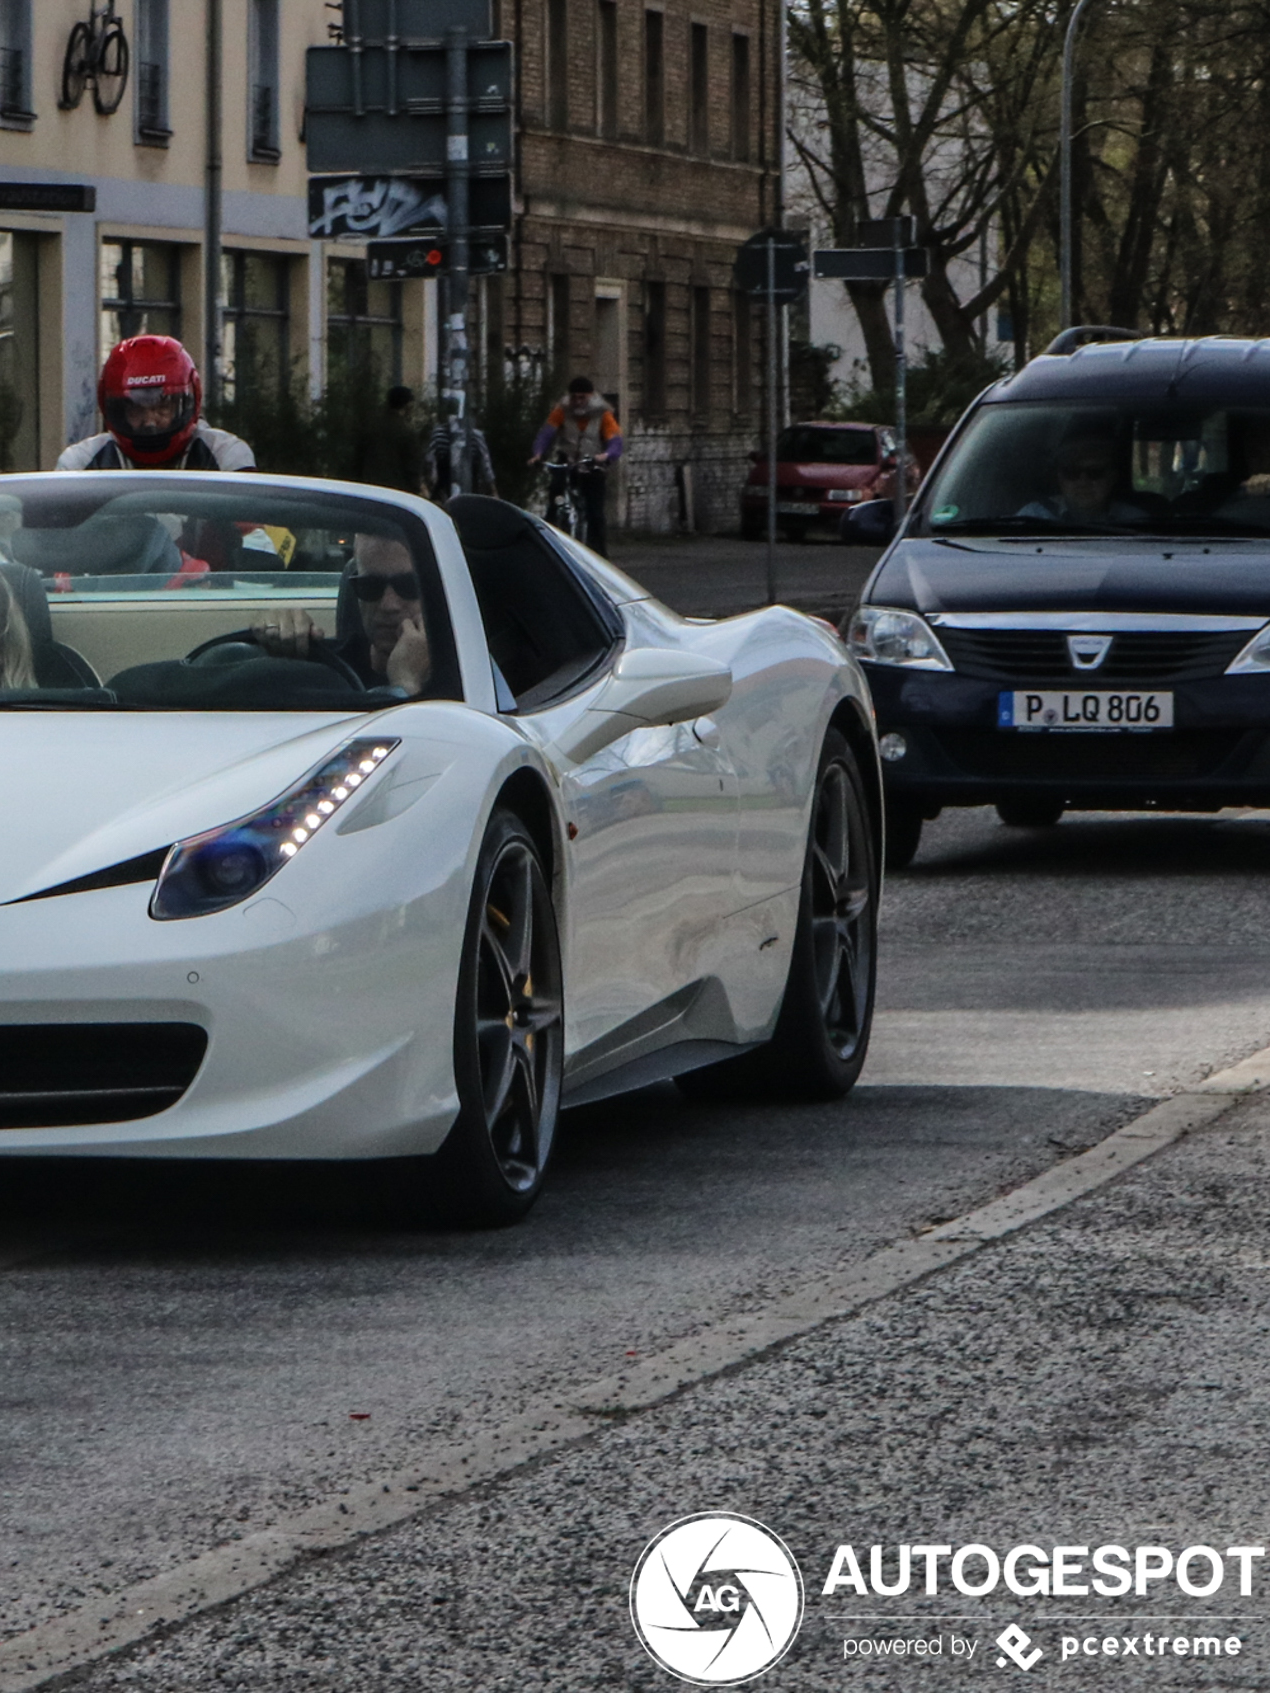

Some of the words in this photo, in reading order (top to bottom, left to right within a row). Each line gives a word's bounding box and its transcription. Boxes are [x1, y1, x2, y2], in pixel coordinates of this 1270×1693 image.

[127, 374, 166, 386] DUCATI
[1026, 694, 1043, 722] P
[1063, 694, 1100, 722] LQ
[1107, 694, 1160, 722] 806
